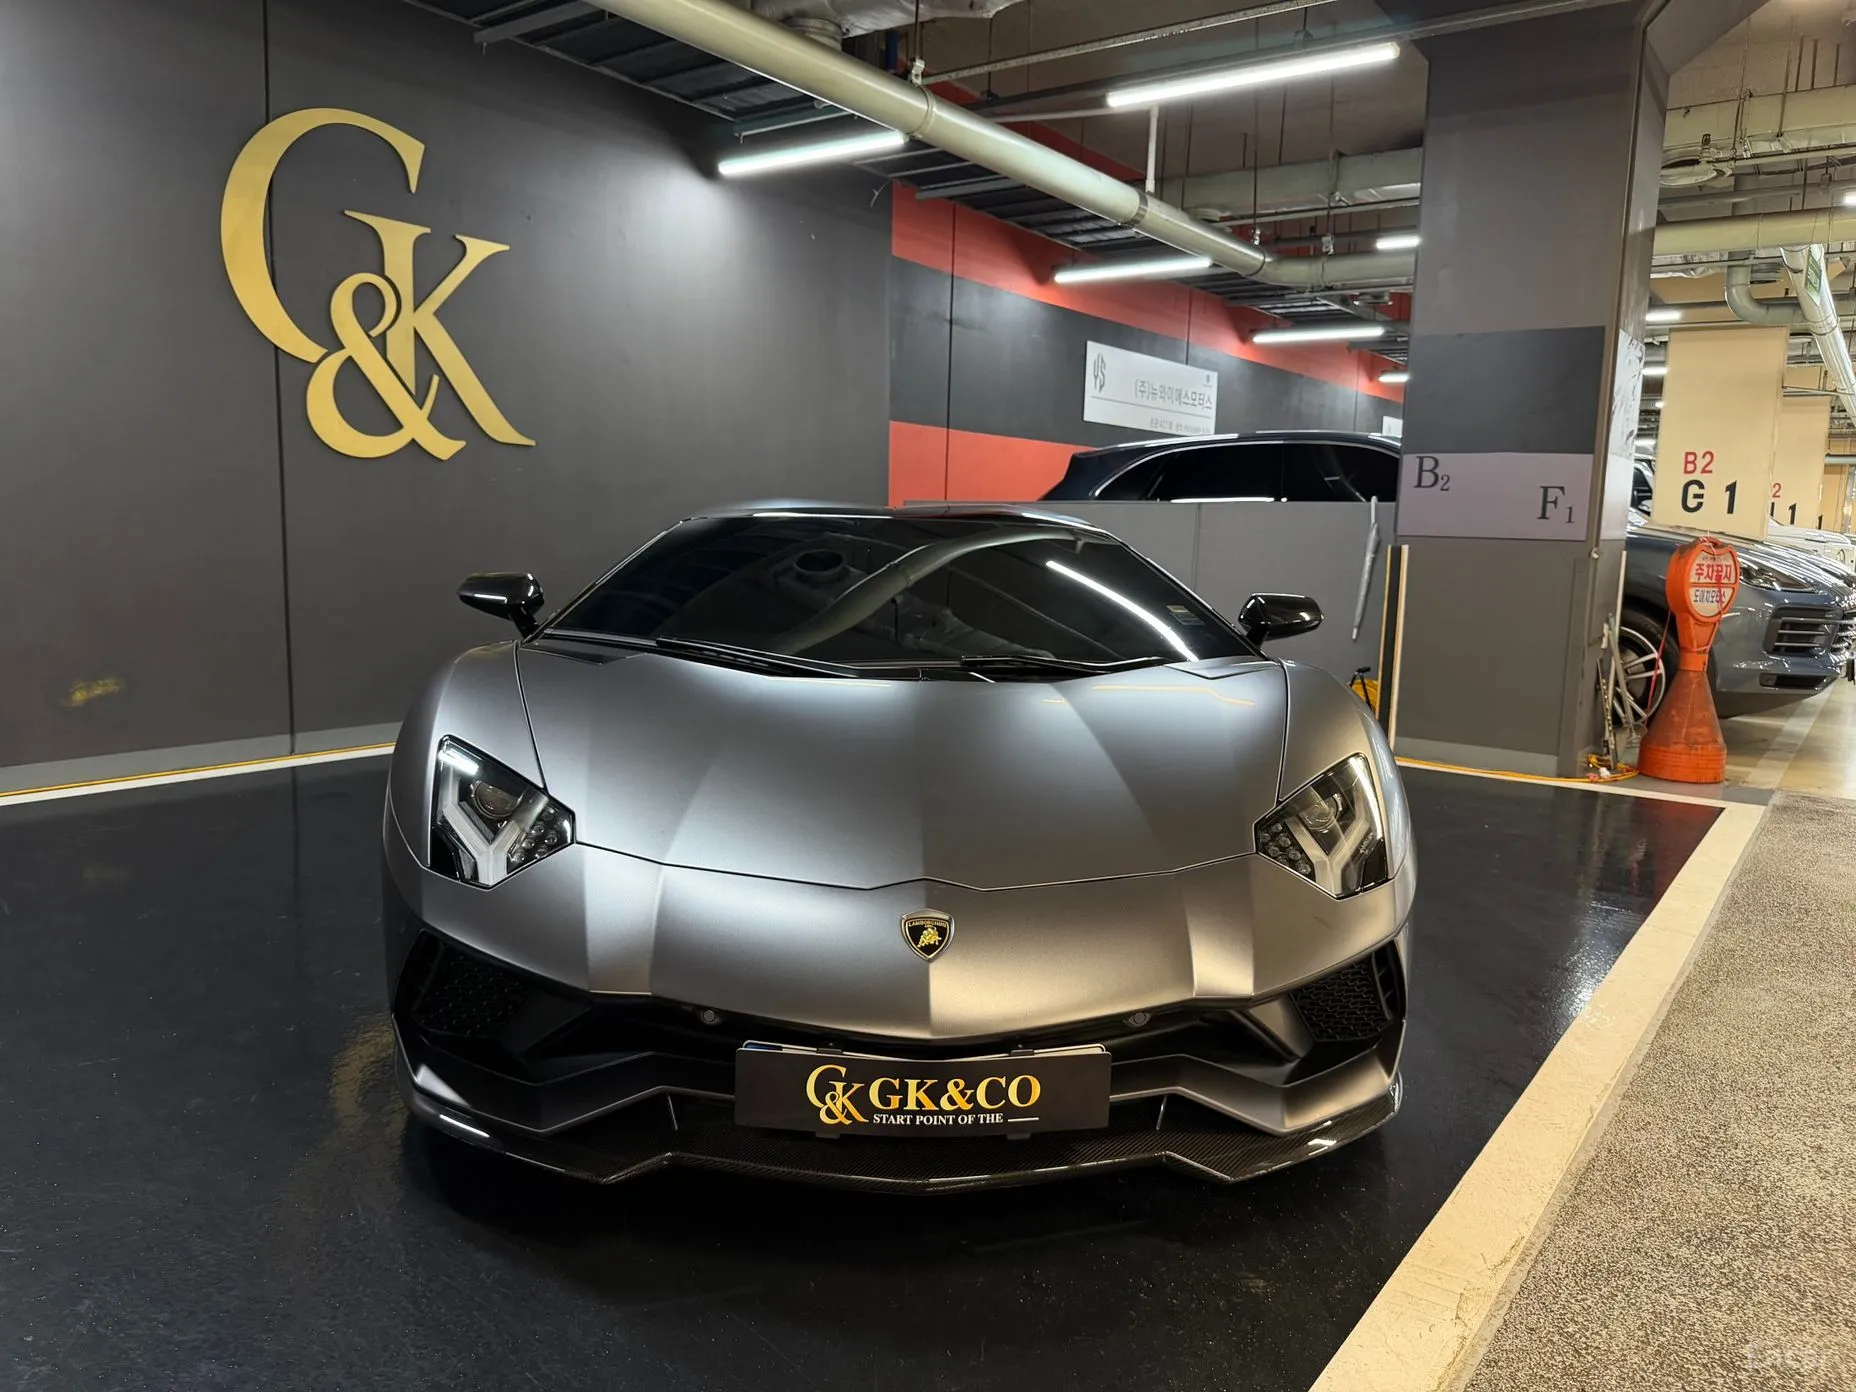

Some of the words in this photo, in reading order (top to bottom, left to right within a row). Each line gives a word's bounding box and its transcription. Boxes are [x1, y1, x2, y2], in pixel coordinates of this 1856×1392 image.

[1413, 455, 1450, 491] B2
[1683, 451, 1715, 475] B2
[1771, 482, 1782, 498] 2
[868, 1074, 1041, 1111] GK&CO
[873, 1113, 912, 1125] START
[915, 1114, 956, 1125] POINT
[957, 1114, 976, 1125] OF
[977, 1112, 1004, 1123] THE
